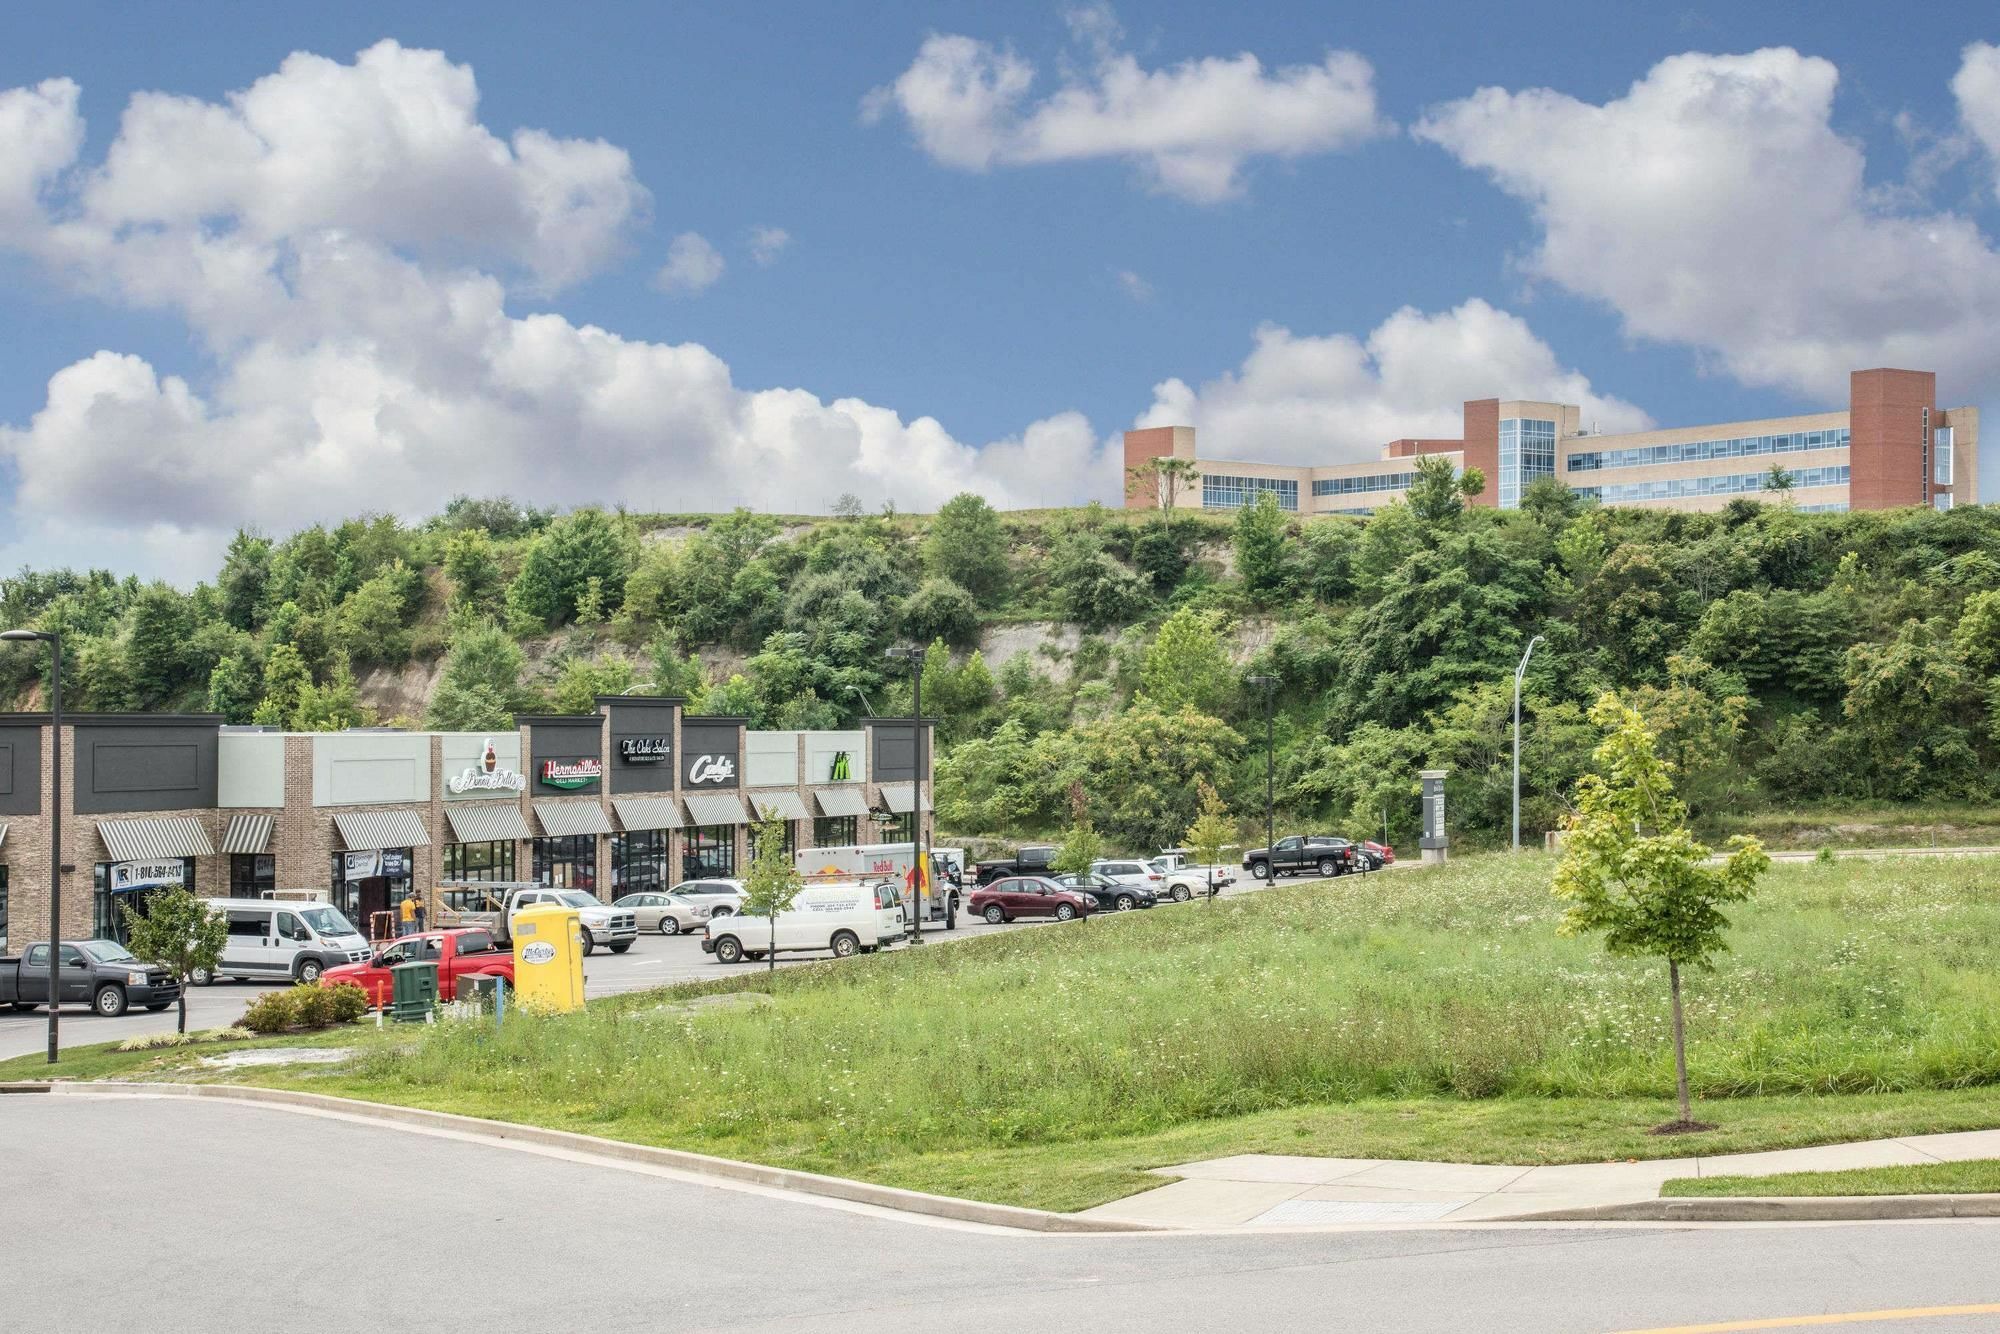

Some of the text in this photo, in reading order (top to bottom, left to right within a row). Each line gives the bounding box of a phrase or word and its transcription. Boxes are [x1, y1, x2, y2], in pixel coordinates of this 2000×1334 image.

[622, 739, 670, 754] The Oaks Salon
[547, 760, 602, 778] Hermosilla's
[873, 860, 893, 872] Red Bull
